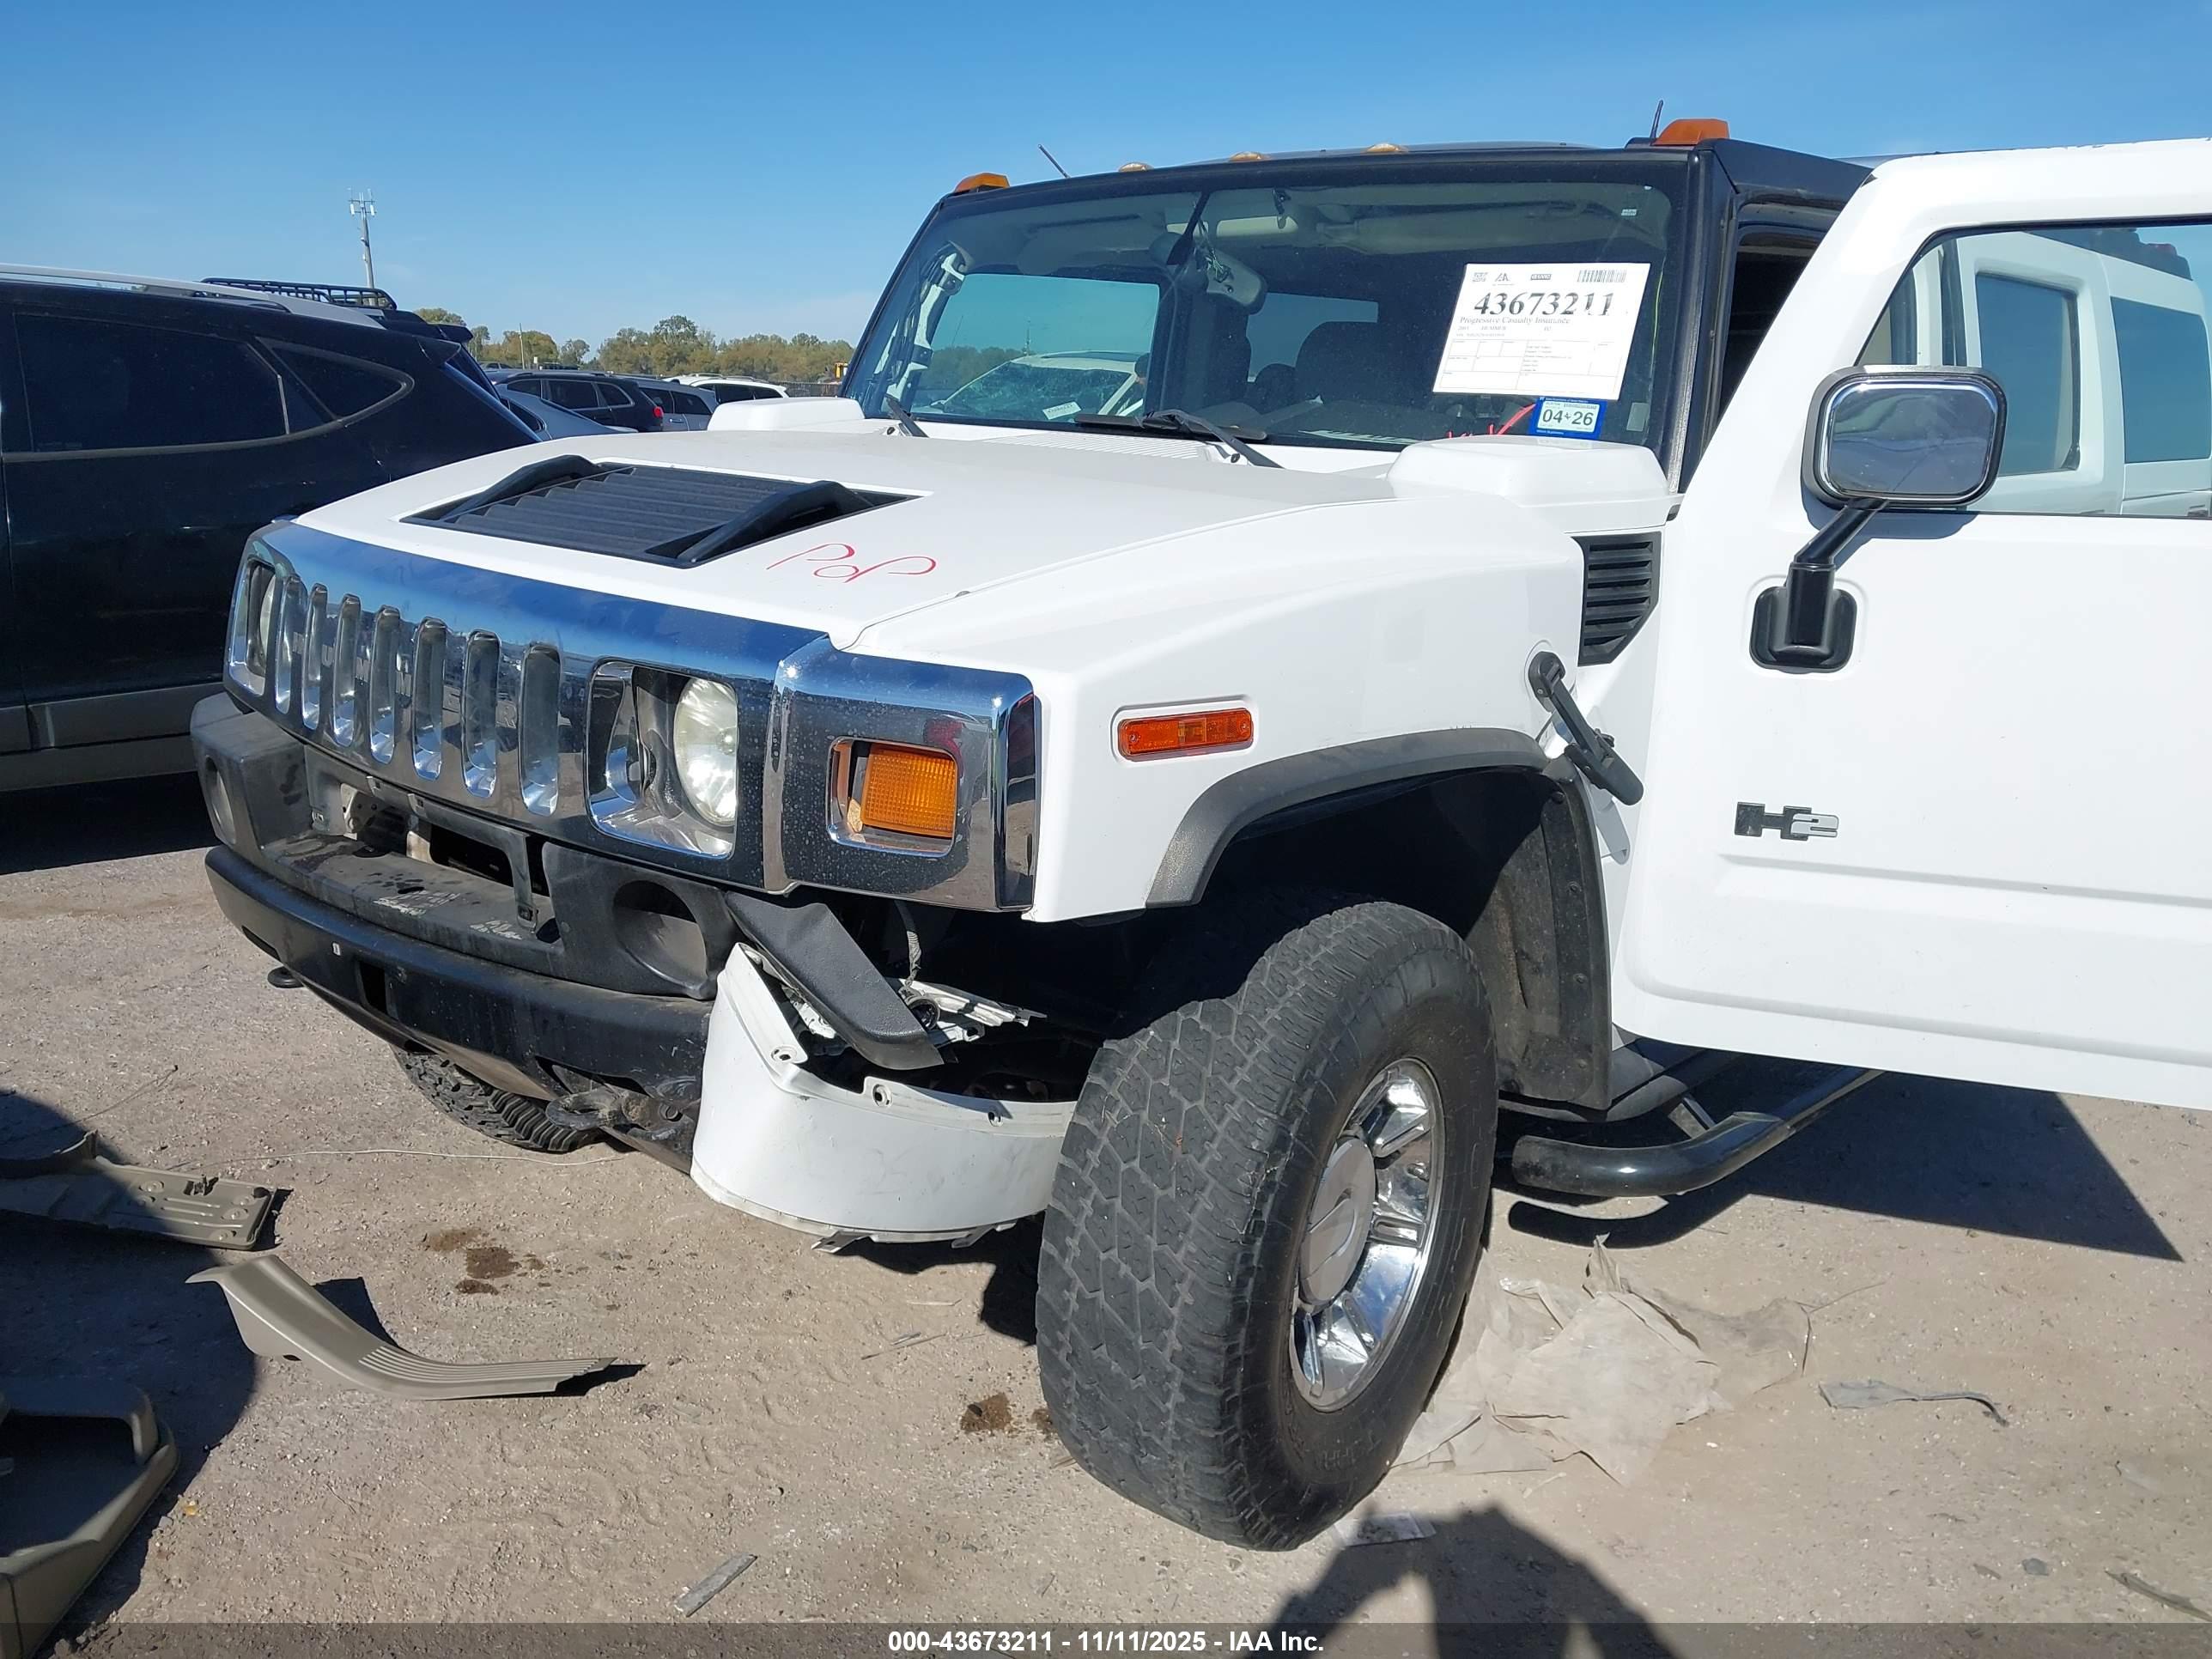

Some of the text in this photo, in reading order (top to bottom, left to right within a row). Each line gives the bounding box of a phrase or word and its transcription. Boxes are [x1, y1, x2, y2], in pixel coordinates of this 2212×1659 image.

[1474, 292, 1614, 316] 43673211
[1542, 409, 1595, 426] 04 26
[1734, 801, 1839, 842] H2
